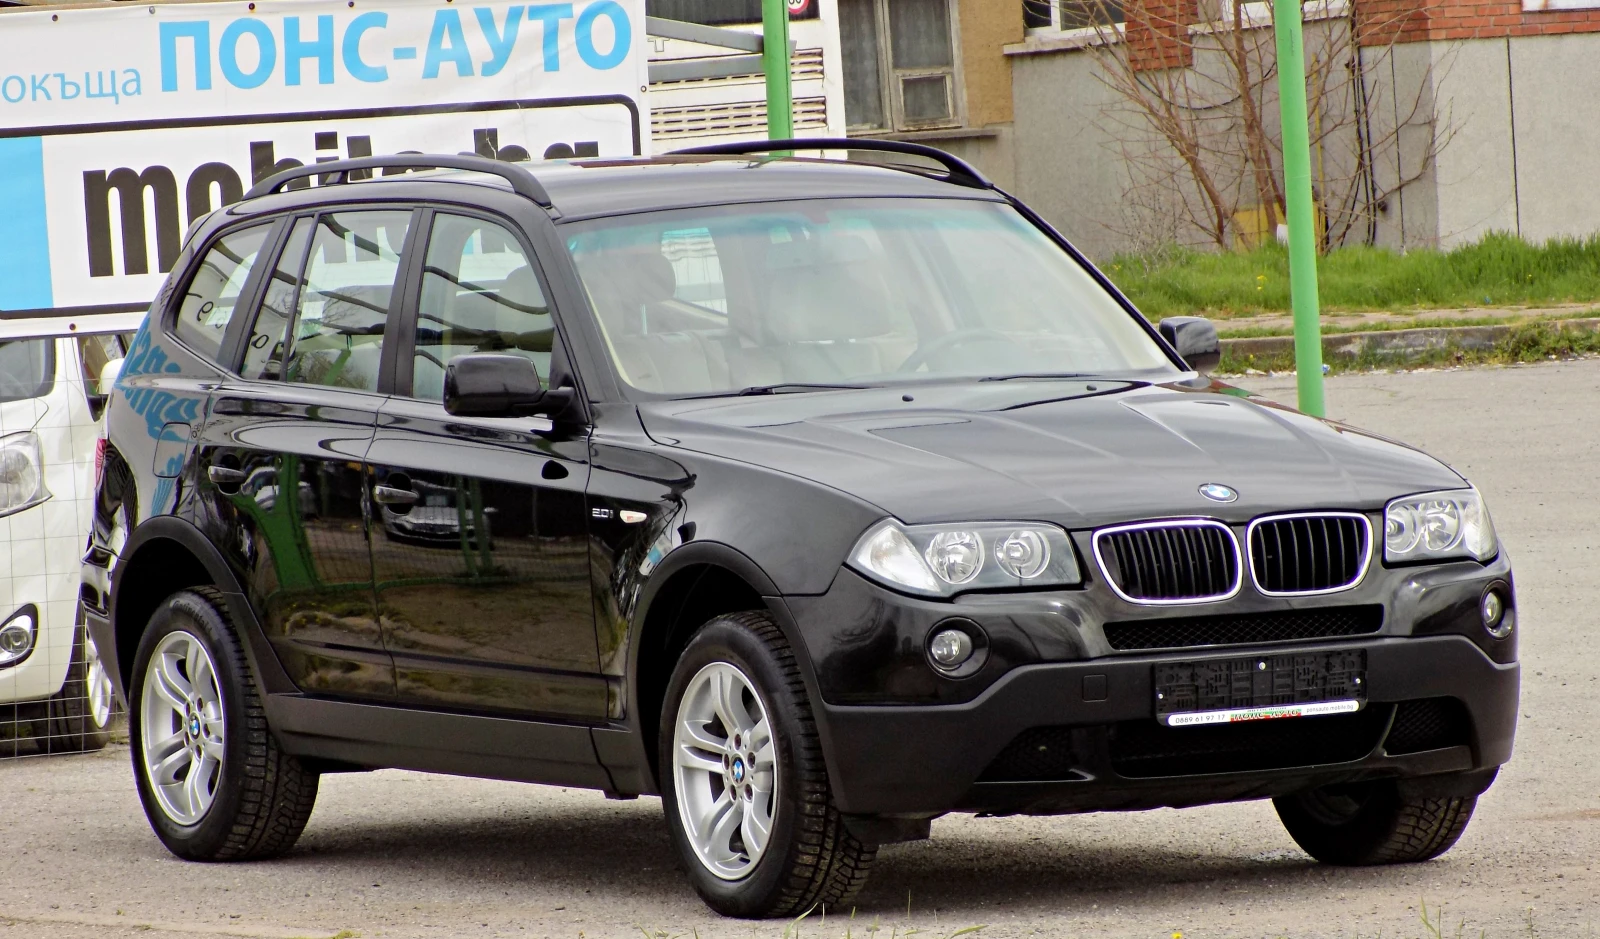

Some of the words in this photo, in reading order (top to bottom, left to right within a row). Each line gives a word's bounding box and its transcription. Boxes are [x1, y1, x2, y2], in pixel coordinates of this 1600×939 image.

[0, 68, 142, 105] окъща
[160, 1, 632, 93] ПОНС-АУТО
[1175, 716, 1193, 724] 0889
